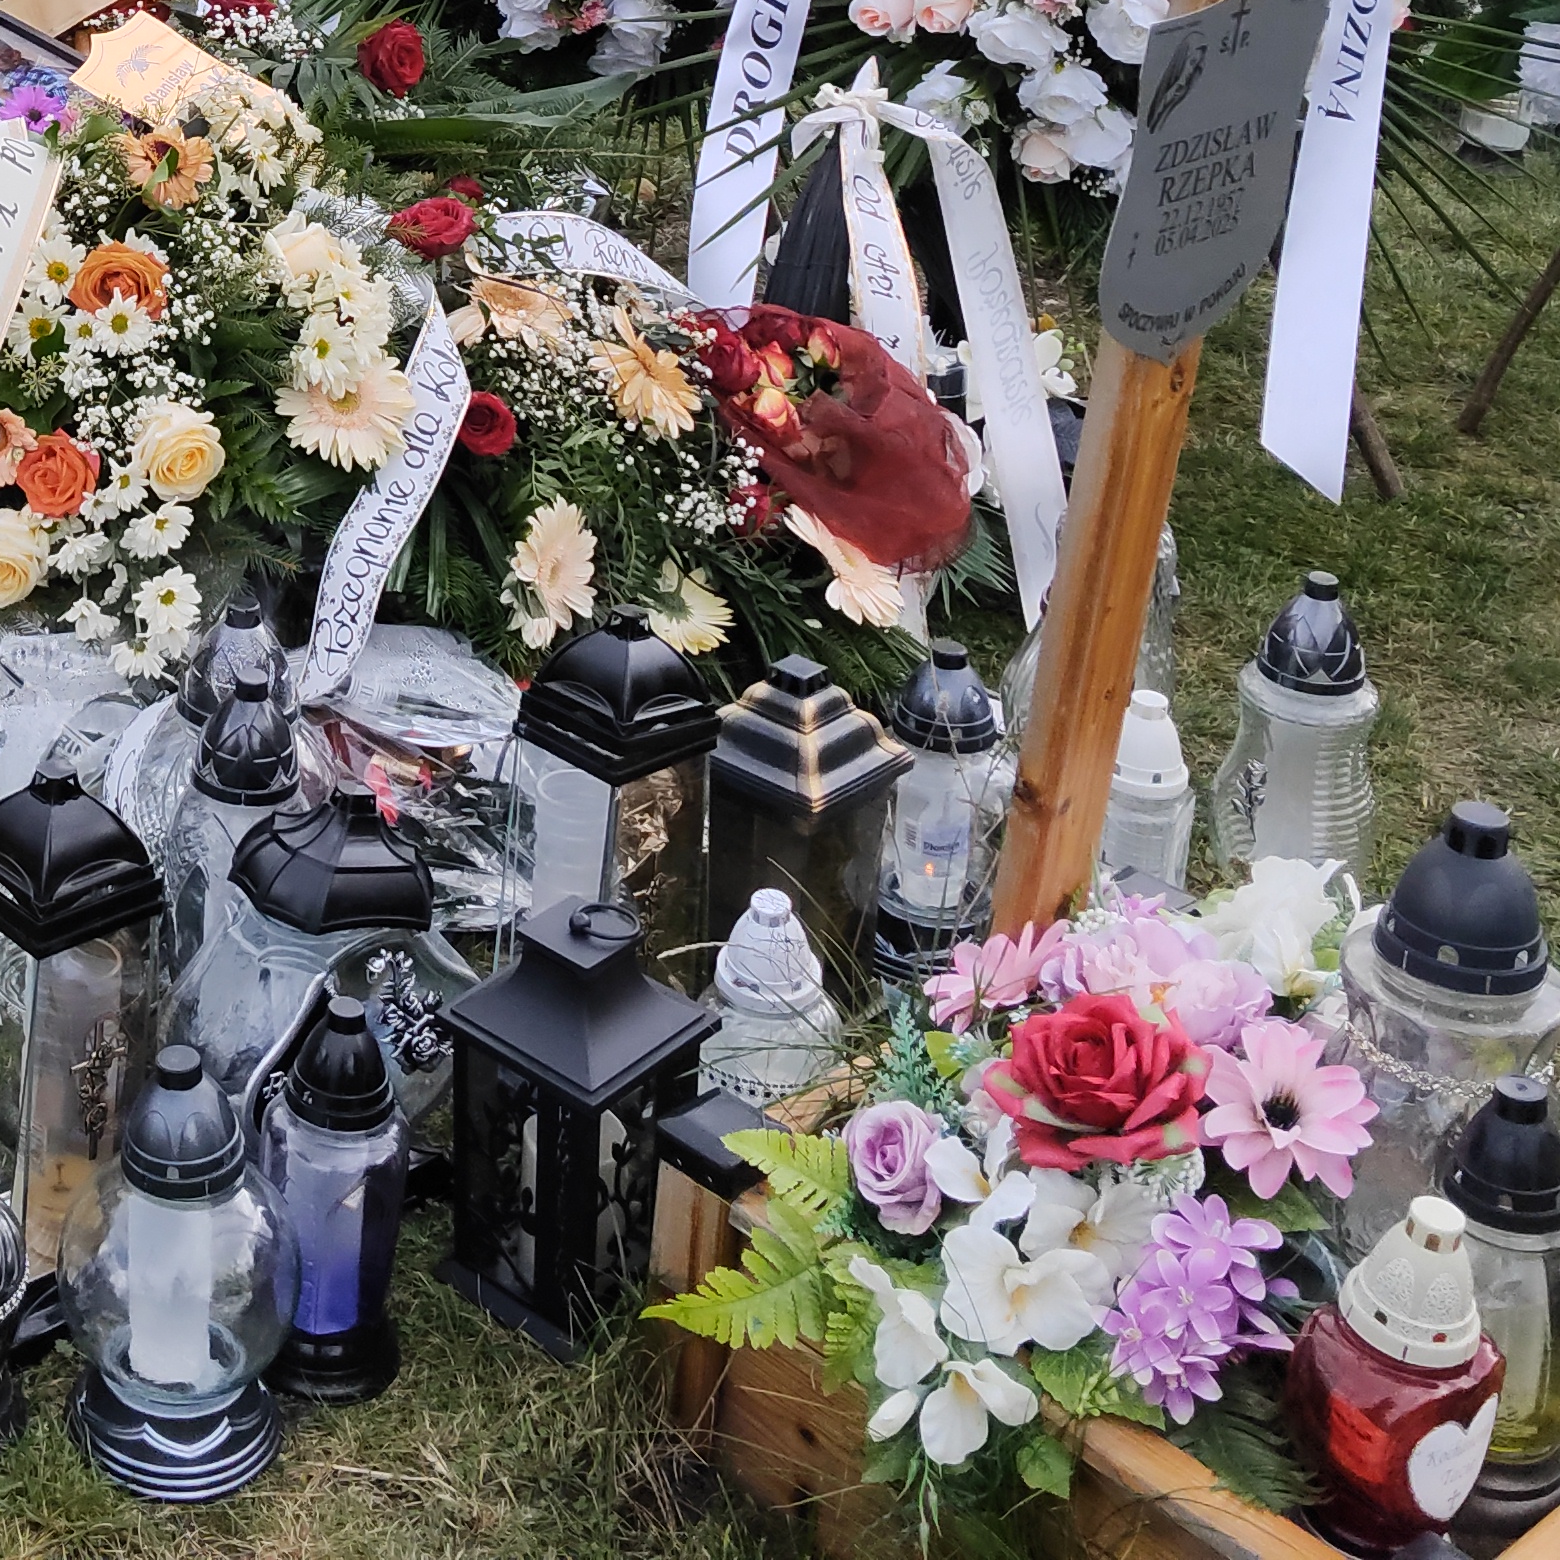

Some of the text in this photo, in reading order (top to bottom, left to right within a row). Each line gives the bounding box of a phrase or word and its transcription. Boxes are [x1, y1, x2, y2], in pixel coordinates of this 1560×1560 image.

[0, 137, 36, 176] Od
[1154, 111, 1279, 175] ZDZISŁAW
[1158, 151, 1257, 208] RZEPKA
